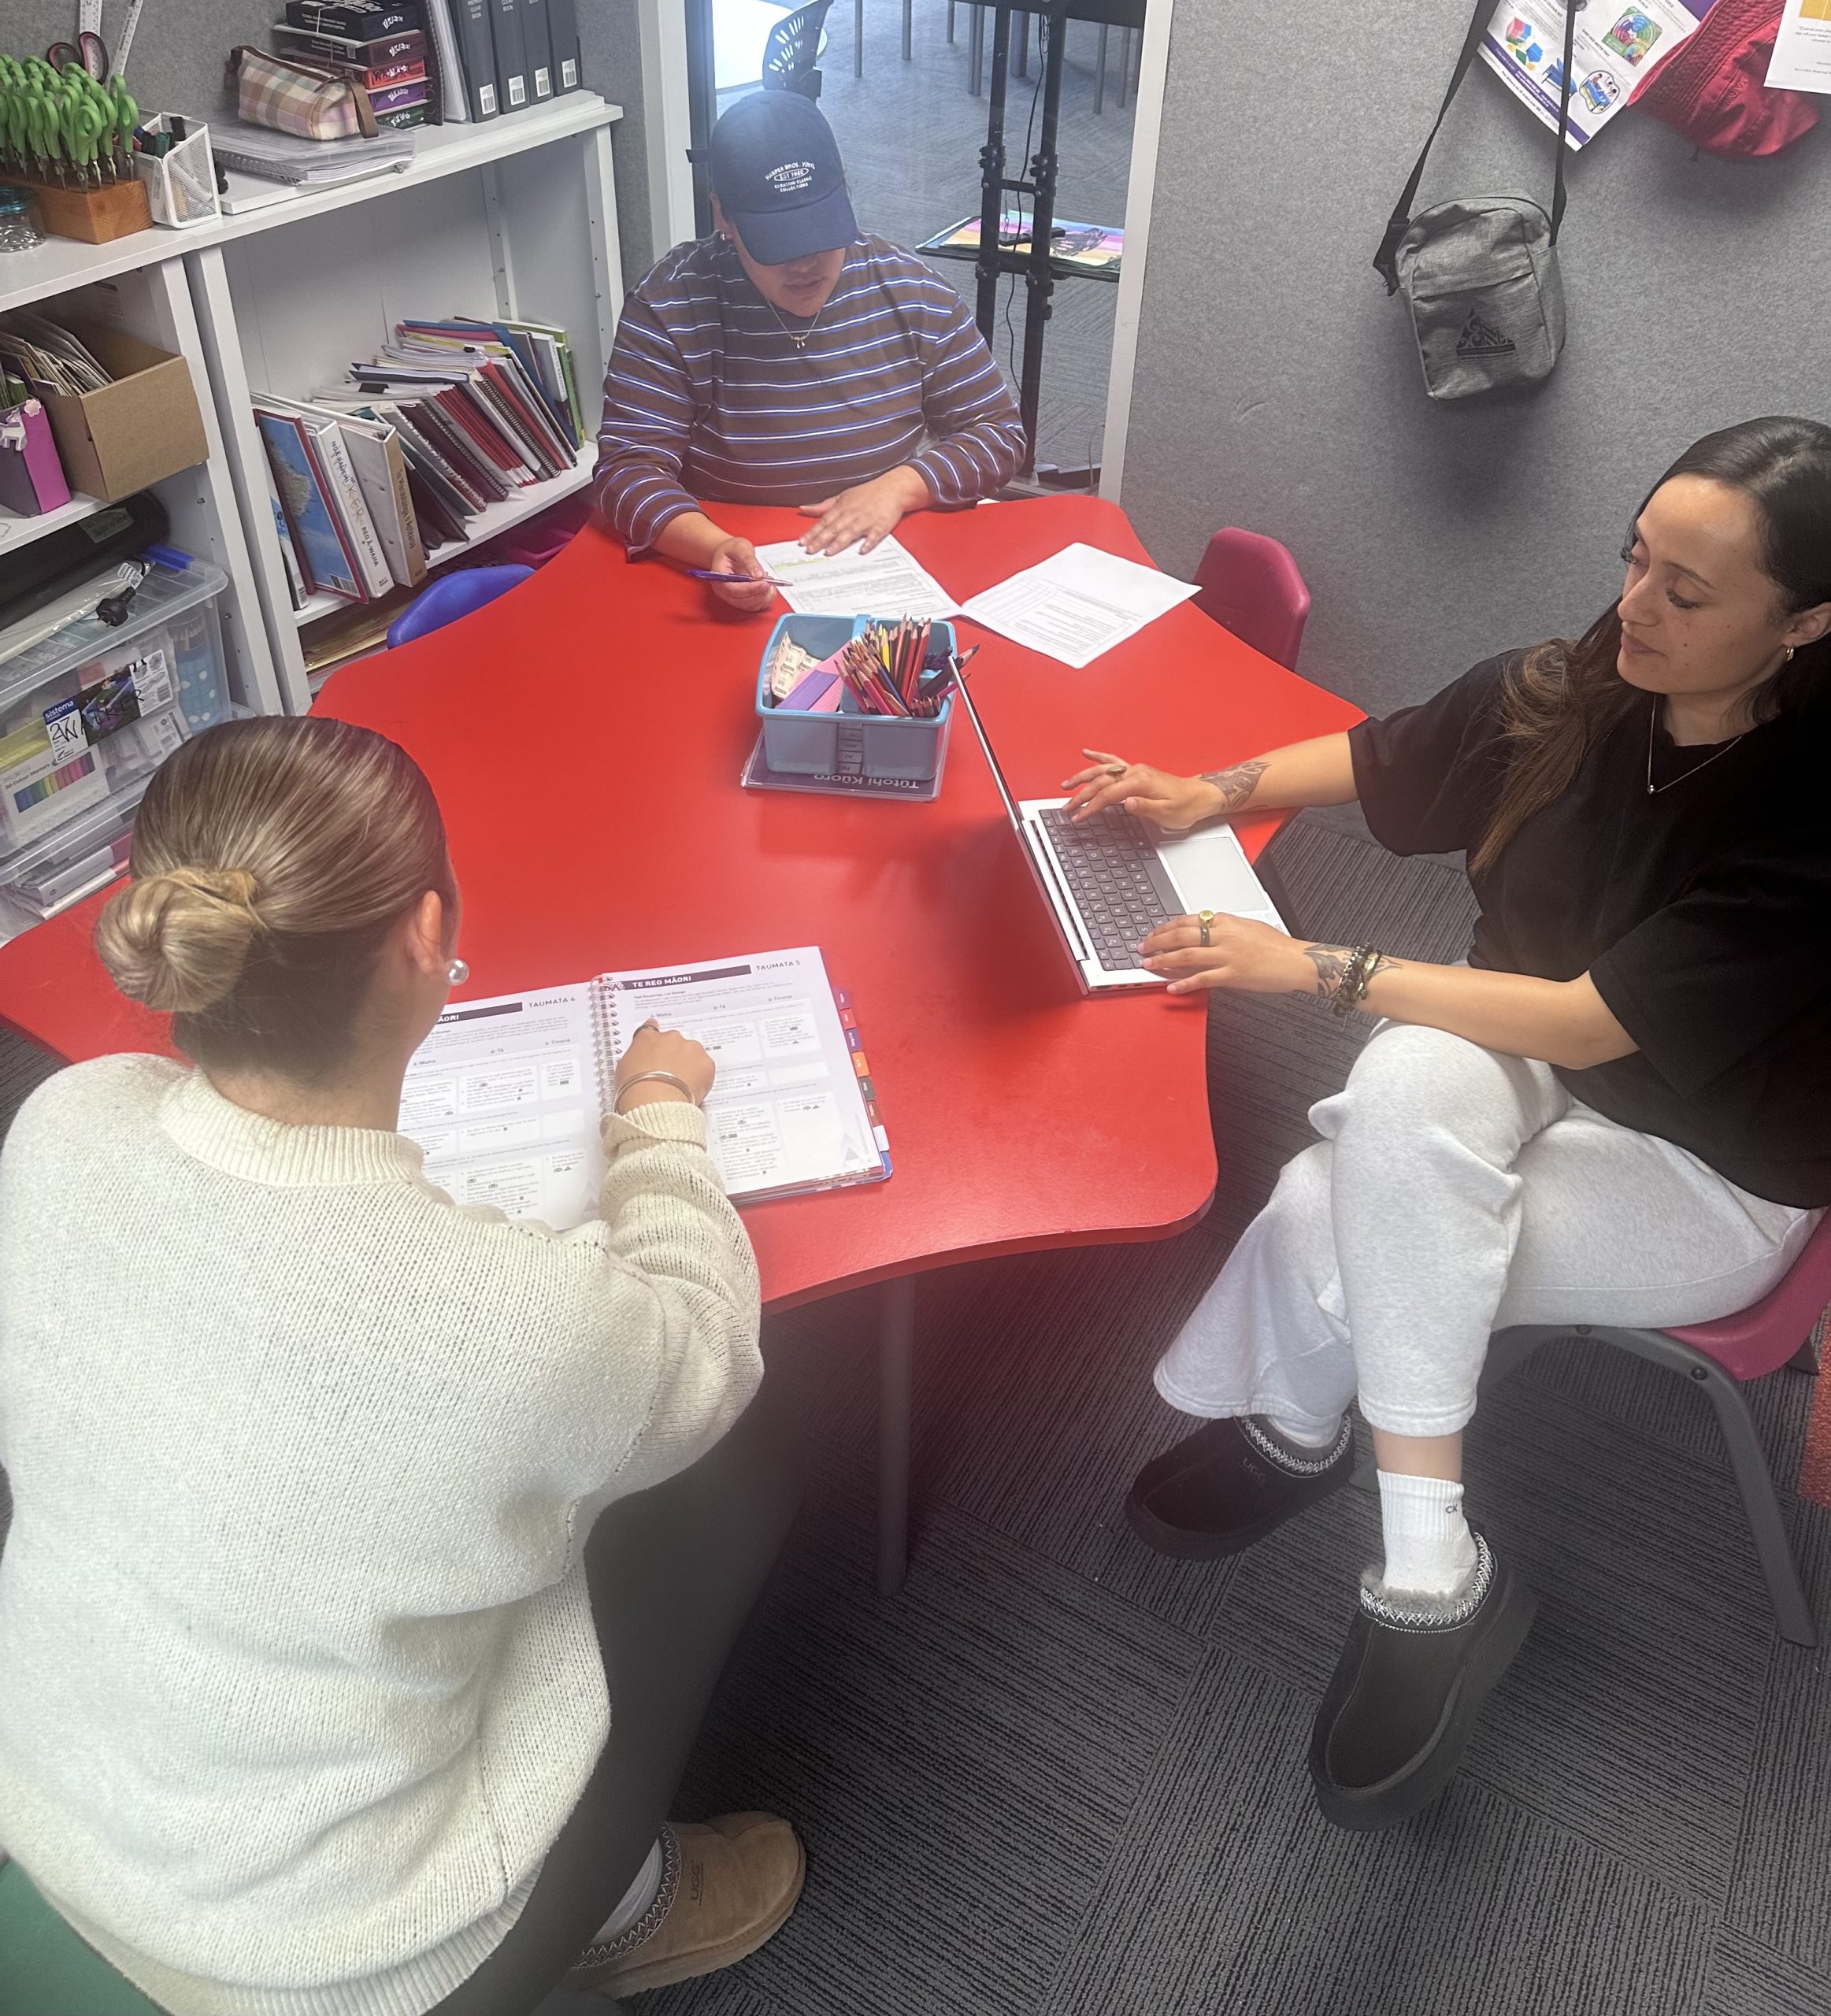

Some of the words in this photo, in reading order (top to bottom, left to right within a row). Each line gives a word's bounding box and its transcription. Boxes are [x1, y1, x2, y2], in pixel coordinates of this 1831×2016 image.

[765, 166, 784, 180] HARPER
[802, 161, 815, 170] VINYL
[45, 699, 75, 720] sistema
[869, 776, 920, 788] Tūtohi
[756, 961, 795, 971] TAUMATA
[664, 976, 692, 984] MĀORI
[529, 998, 569, 1008] TAUMATA
[438, 1014, 459, 1023] ĀORI
[690, 1862, 701, 1901] UGG
